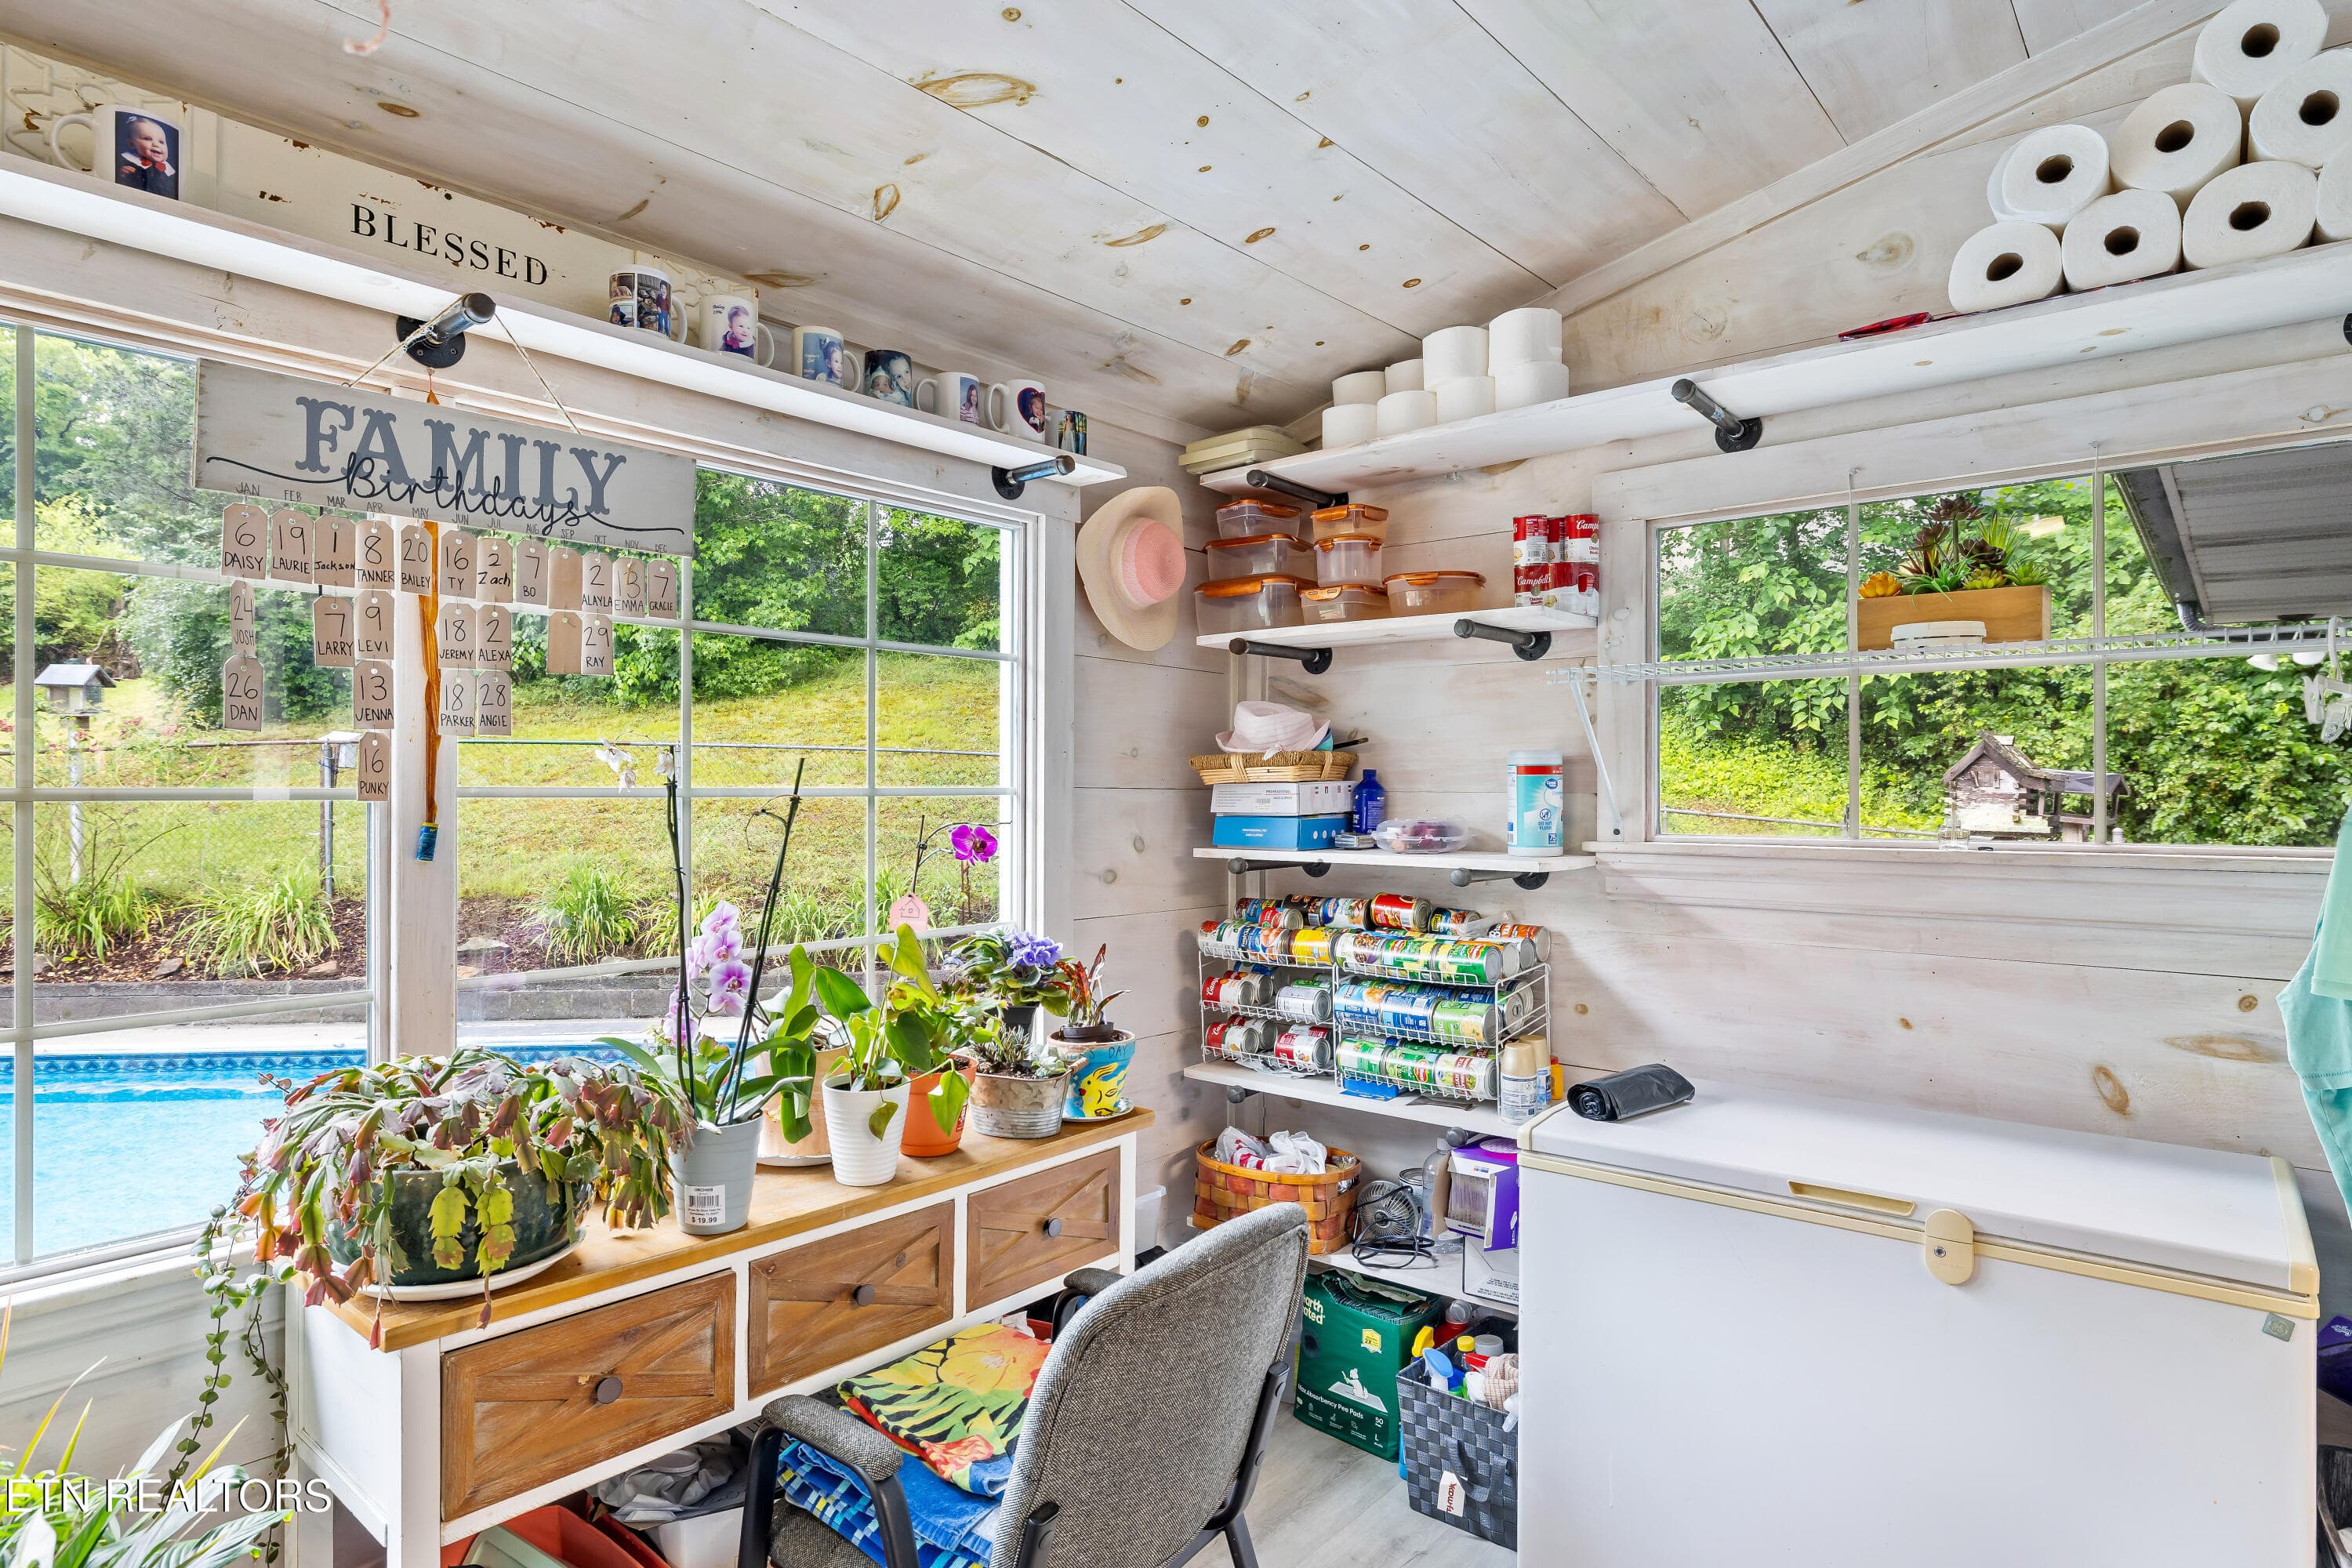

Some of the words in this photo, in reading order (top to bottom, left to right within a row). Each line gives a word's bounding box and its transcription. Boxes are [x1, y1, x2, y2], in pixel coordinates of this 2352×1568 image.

[350, 203, 548, 285] BLESSED
[295, 396, 627, 516] FAMILY
[235, 481, 261, 496] JAN
[284, 489, 302, 503] FEB
[345, 451, 590, 536] Birthdays
[327, 495, 347, 508] MAR
[366, 501, 387, 514] APR
[412, 507, 429, 520] MAY
[452, 514, 469, 526] JUN
[487, 517, 505, 530] JUL
[526, 524, 539, 535] AUG
[234, 521, 256, 546] 6
[279, 524, 306, 555] 19
[561, 528, 575, 540] SEP
[594, 534, 608, 546] OCT
[364, 535, 383, 564] 8
[403, 539, 428, 563] 20
[625, 539, 639, 550] NOV
[655, 544, 667, 554] DEC
[224, 551, 264, 572] DAISY
[272, 557, 310, 575] LAURIE
[446, 546, 469, 570] 16
[488, 553, 503, 567] 2
[524, 555, 540, 579] 7
[590, 564, 604, 586] 2
[356, 568, 395, 584] TANNER
[401, 572, 431, 590] BAILEY
[447, 576, 465, 591] TY
[477, 571, 511, 587] Zach
[523, 585, 536, 597] BO
[617, 570, 641, 599] 13
[654, 575, 669, 598] 7
[583, 593, 612, 608] ALAYLA
[615, 599, 644, 612] EMMA
[649, 601, 673, 612] GRACIE
[234, 595, 254, 625] 24
[325, 613, 346, 637] 7
[365, 606, 382, 631] 9
[234, 628, 255, 647] JOSH
[445, 618, 466, 642] 18
[486, 619, 503, 643] 2
[583, 626, 610, 648] 29
[318, 641, 354, 656] LARRY
[358, 640, 389, 653] LEVI
[439, 648, 474, 660] JEREMY
[478, 648, 511, 662] ALEXA
[586, 656, 605, 668] RAY
[228, 673, 259, 699] 26
[360, 675, 387, 701] 13
[445, 684, 464, 712] 18
[480, 684, 506, 707] 28
[230, 704, 258, 721] DAN
[355, 707, 394, 722] JENNA
[441, 713, 474, 728] PARKER
[479, 713, 508, 728] ANGIE
[364, 748, 384, 774] 16
[359, 781, 389, 795] PUNKY
[1109, 1046, 1127, 1059] DAY
[1304, 1307, 1323, 1325] ated
[1306, 1391, 1338, 1409] Absorbency
[1338, 1403, 1348, 1413] Pee
[1349, 1408, 1363, 1419] Pads
